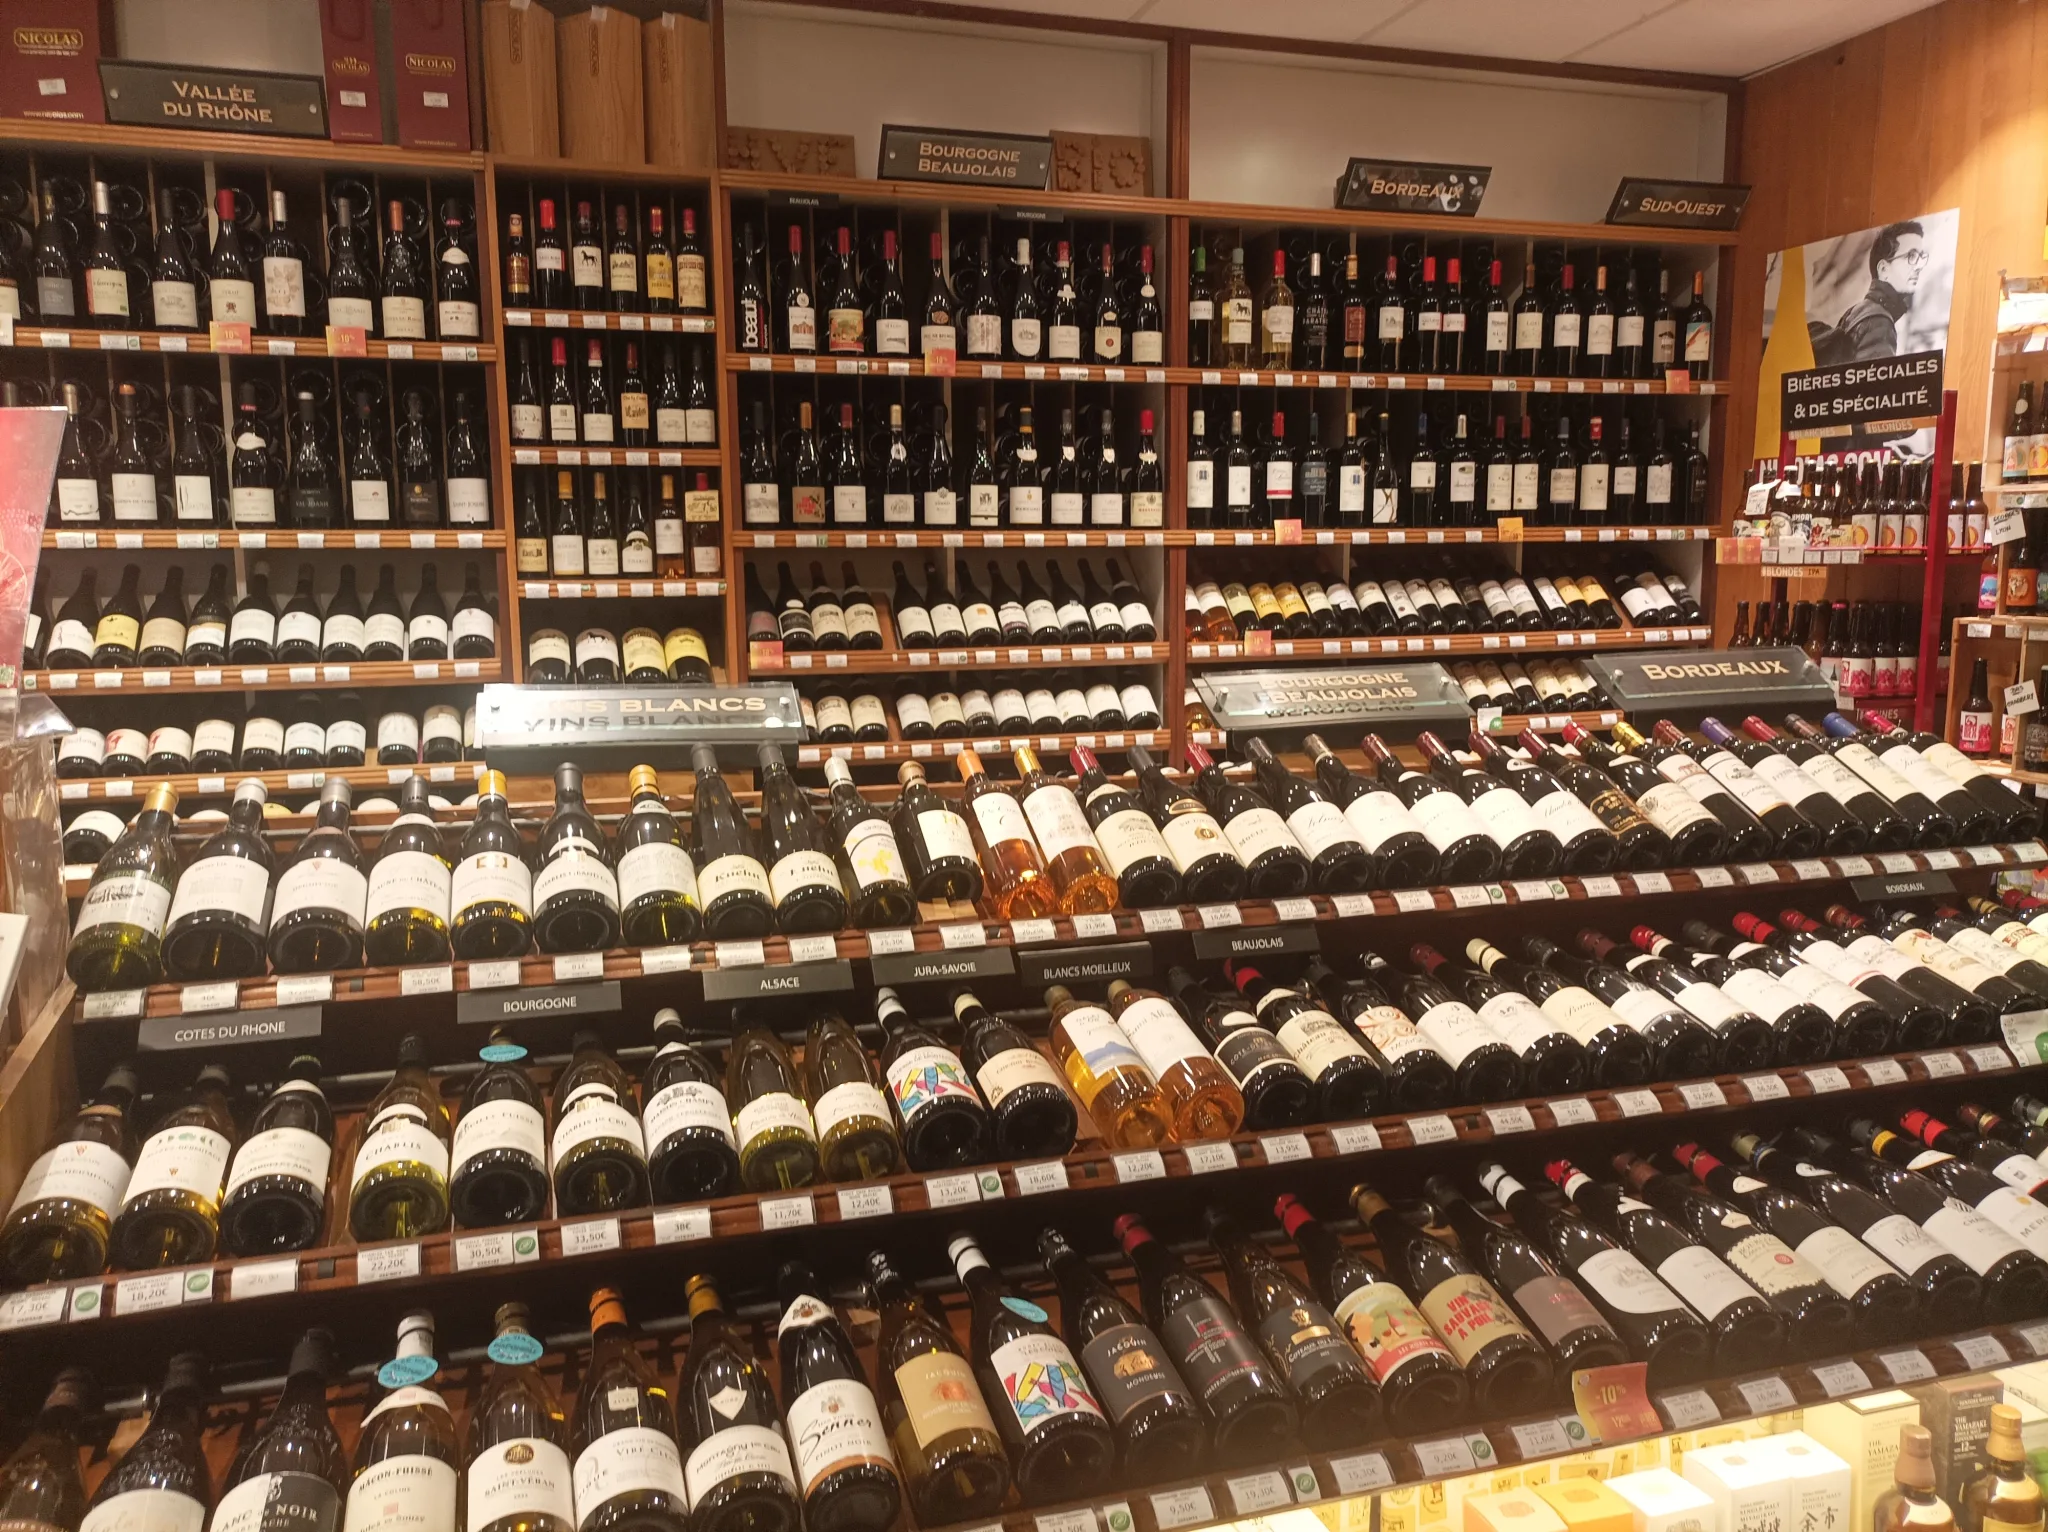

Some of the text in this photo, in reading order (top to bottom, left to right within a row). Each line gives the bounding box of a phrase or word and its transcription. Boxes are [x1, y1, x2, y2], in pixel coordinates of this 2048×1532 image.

[19, 31, 79, 46] NICOLAS
[409, 56, 453, 70] NICOLAS
[172, 80, 257, 103] VALLÉE
[163, 98, 273, 123] DU RHÔNE
[919, 141, 1020, 163] BOURGOGNE
[918, 157, 1017, 179] BEAUJOLAIS
[1370, 179, 1465, 199] BORDEAUX
[1639, 196, 1726, 216] SUD-OUEST
[1787, 358, 1939, 394] BIÈRES SPÉCIALES
[1794, 385, 1928, 419] & DE SPÉCIALITÉ
[1642, 659, 1790, 680] BORDEAUX
[1269, 684, 1417, 705] BEAUJOLAIS
[619, 697, 766, 713] BLANCS
[1885, 882, 1925, 895] BORDEAUX
[1231, 936, 1284, 952] BEAUJOLAIS
[913, 961, 977, 978] JURA-SAVOIE
[1043, 960, 1131, 980] BLANCS MOELLEUX
[760, 976, 800, 991] ALSACE
[503, 996, 577, 1013] BOURGOGNE
[174, 1020, 286, 1042] COTES DU RHONE
[366, 1142, 422, 1161] CHABLIS
[1446, 1294, 1471, 1312] VIN
[815, 1439, 873, 1462] PINOT NOIR
[1868, 1443, 1901, 1457] YAMAZA
[276, 1503, 317, 1522] NOIR
